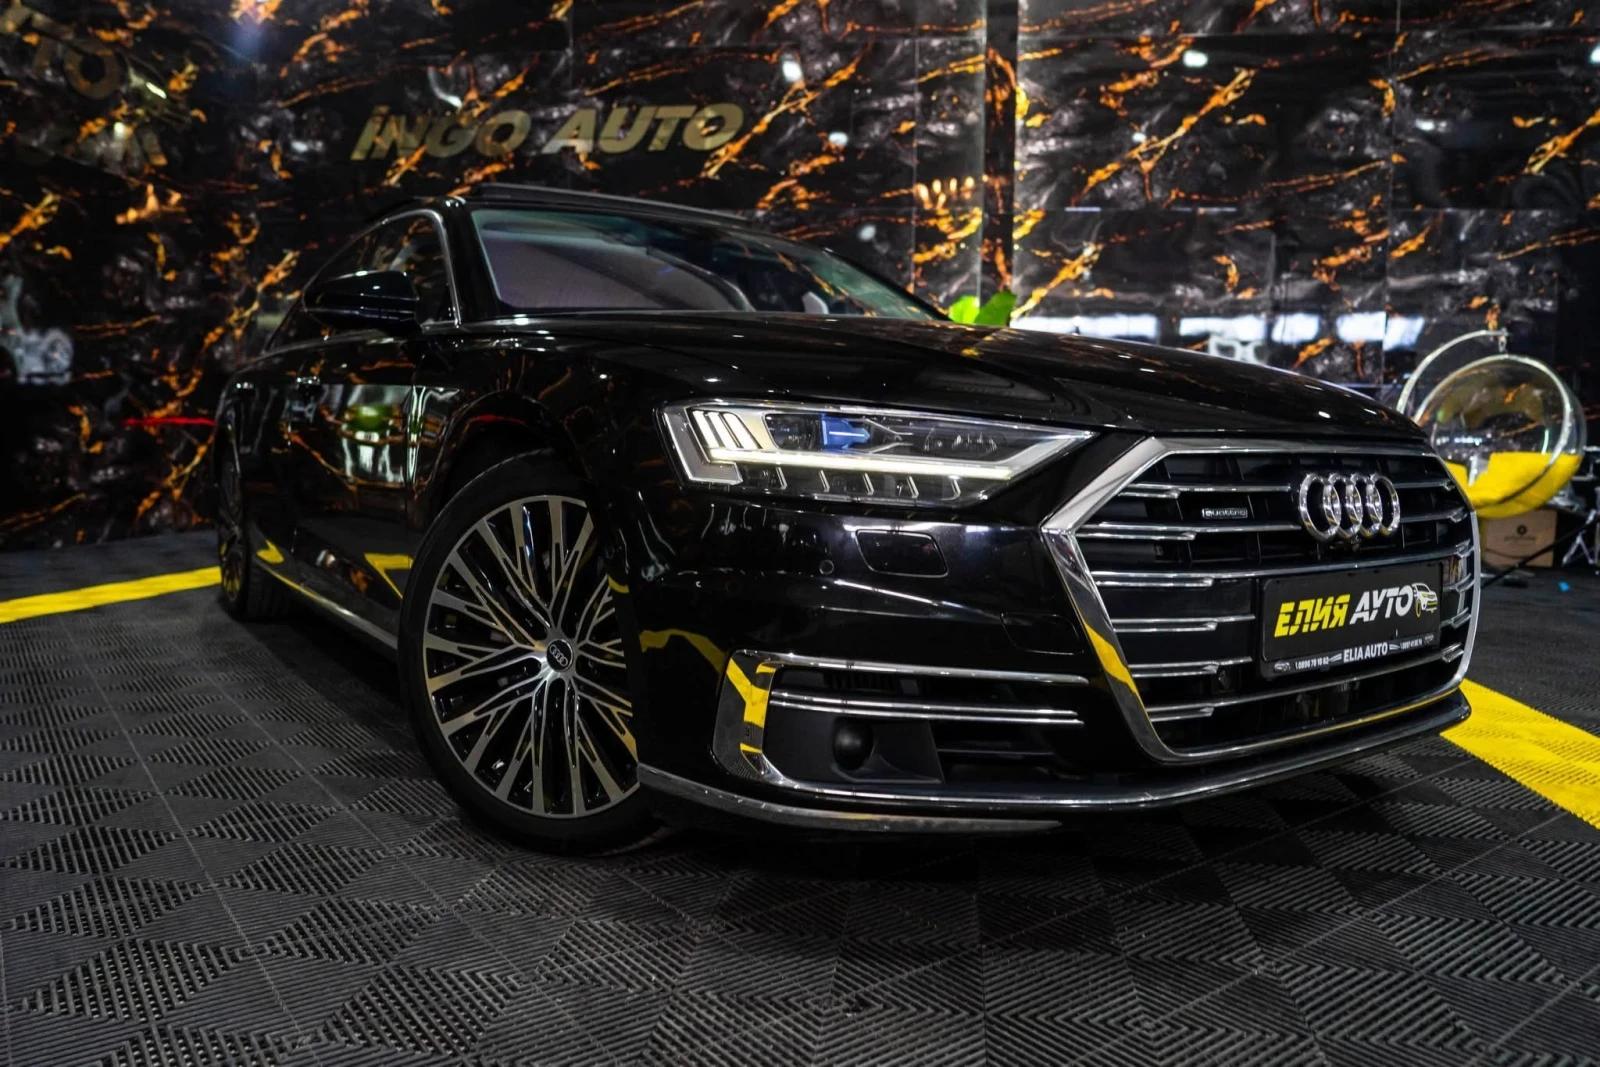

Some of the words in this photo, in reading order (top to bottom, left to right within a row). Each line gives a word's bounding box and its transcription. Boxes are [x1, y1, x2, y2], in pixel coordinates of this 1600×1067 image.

[541, 102, 744, 155] AUTO
[1274, 594, 1350, 638] ЕЛИЯ
[1350, 584, 1413, 625] АУТО
[1343, 646, 1364, 663] ELIA
[1364, 641, 1388, 660] AUTO
